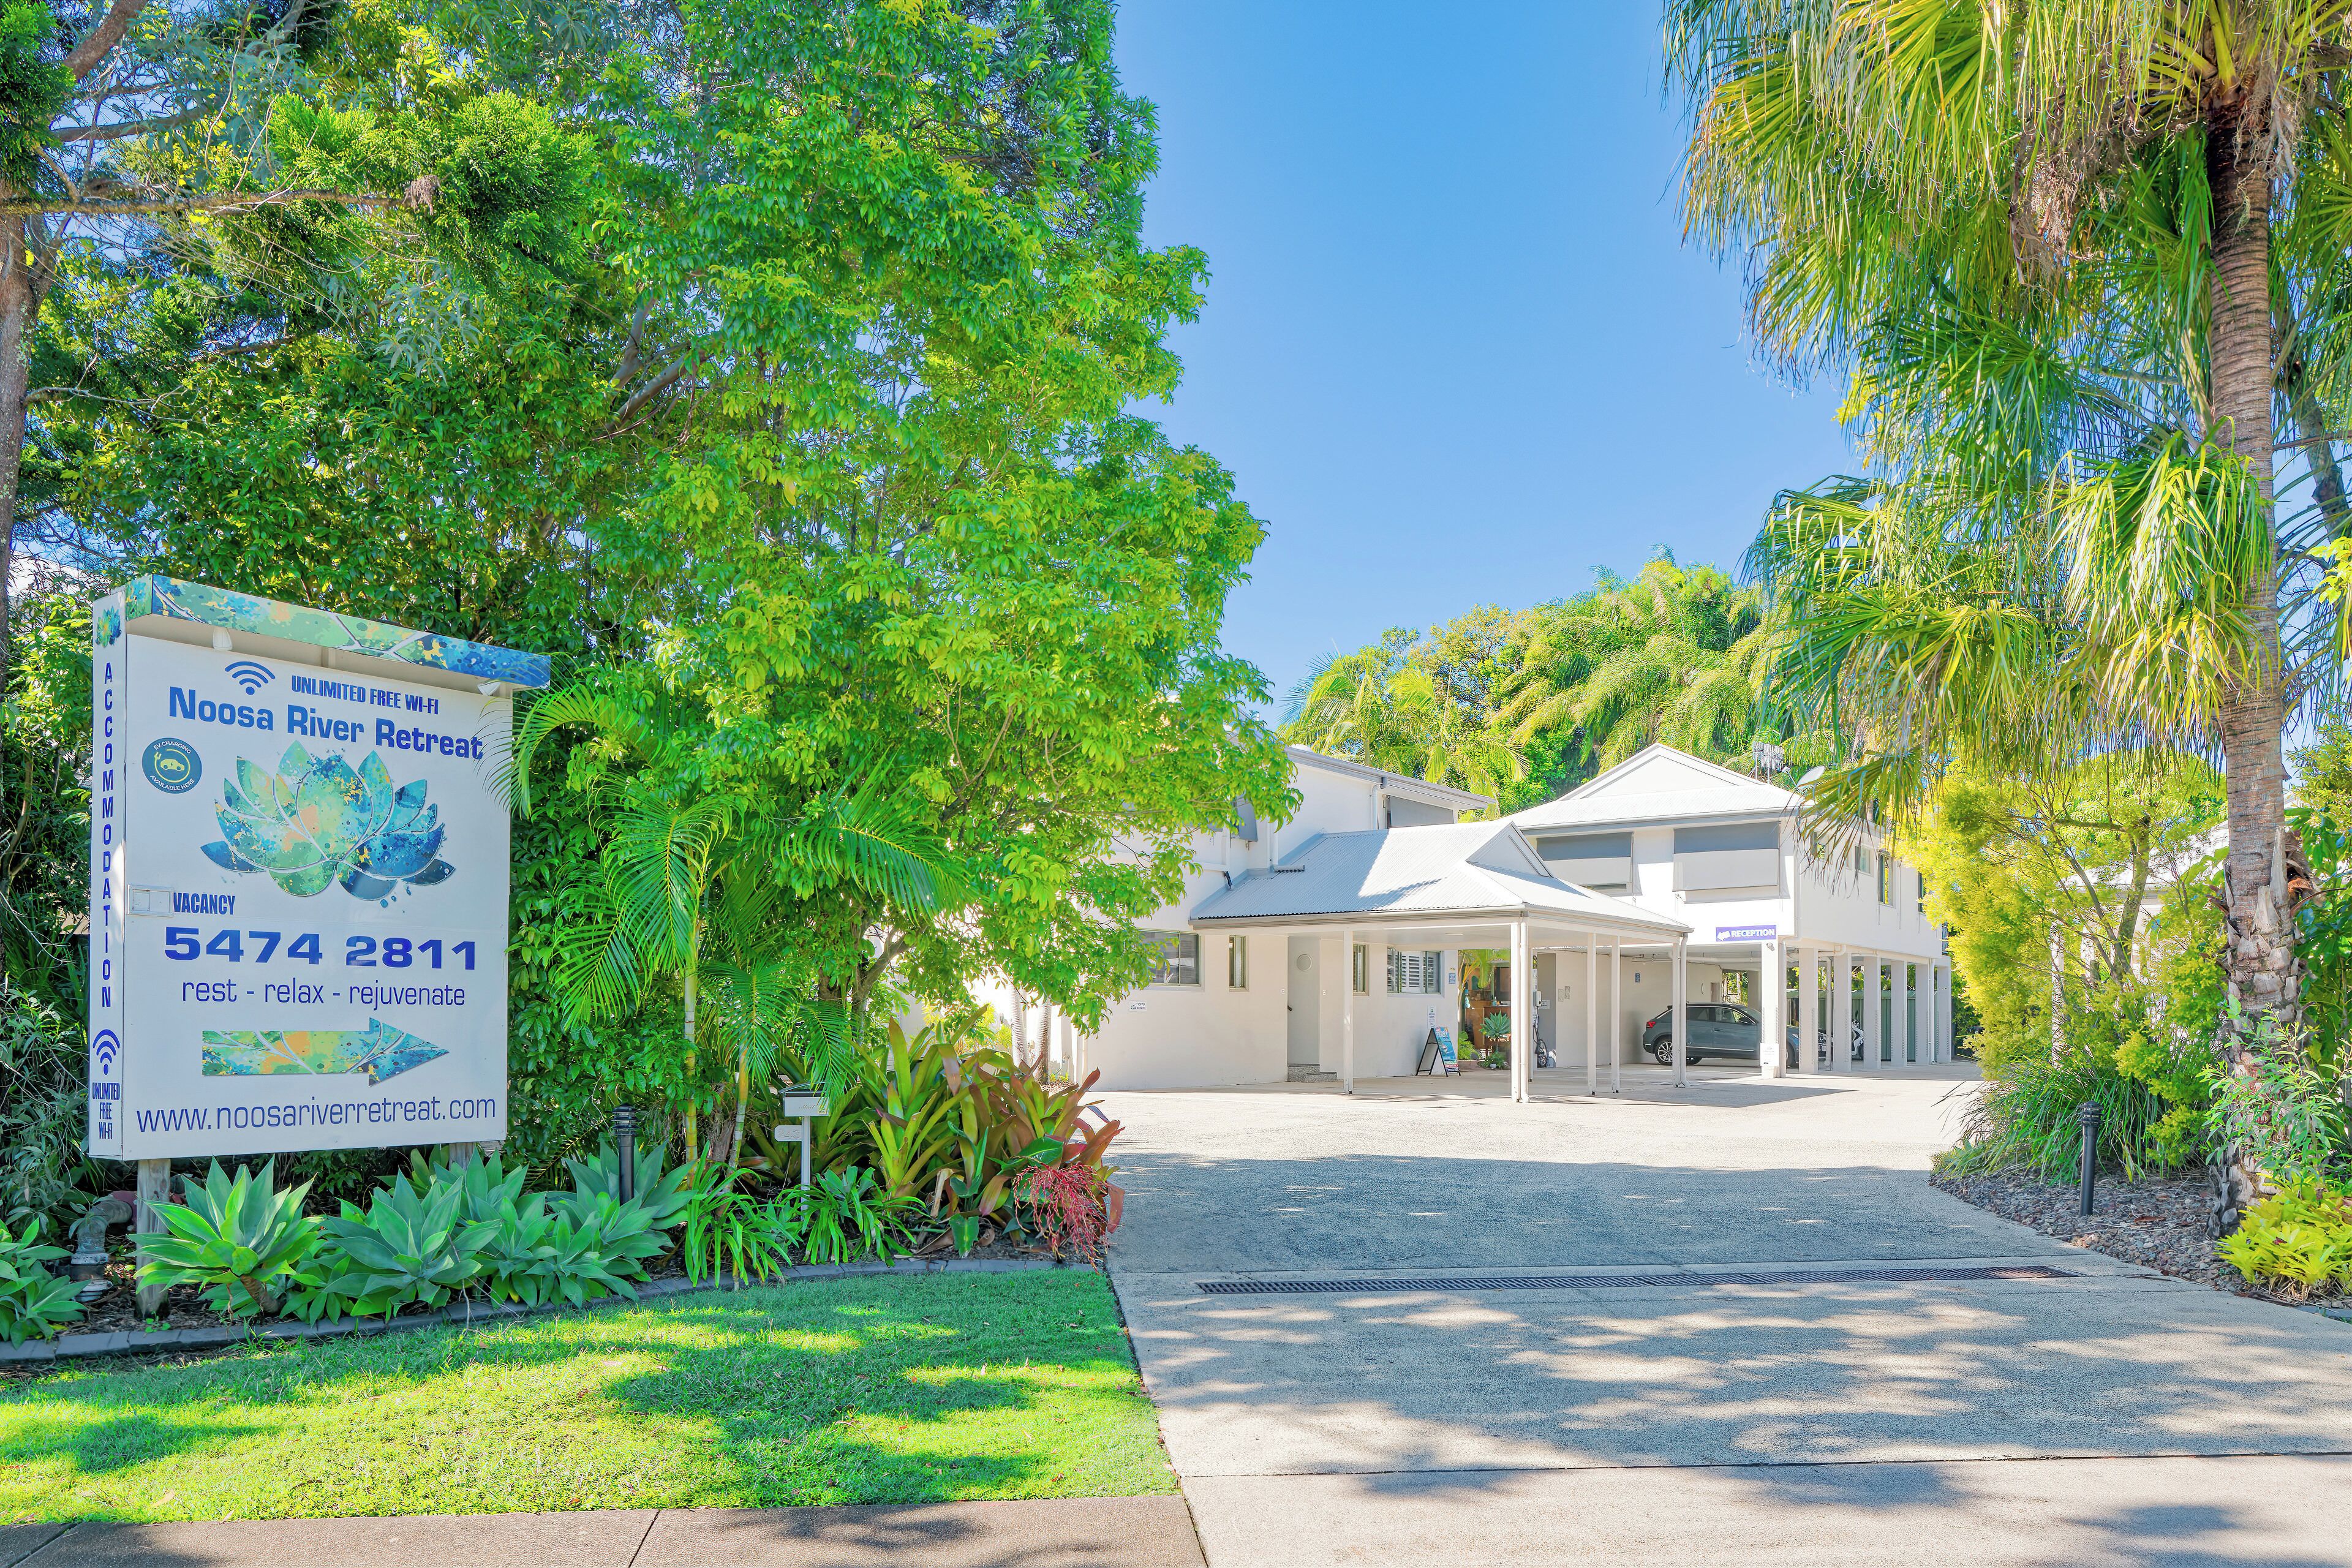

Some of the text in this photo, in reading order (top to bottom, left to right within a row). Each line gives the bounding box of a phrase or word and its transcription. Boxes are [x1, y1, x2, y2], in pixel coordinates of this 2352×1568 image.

[291, 675, 439, 715] UNLIMITED FREE WI-FI
[168, 685, 484, 760] Noosa River Retreat
[161, 740, 192, 754] CHARGING
[149, 774, 195, 791] AVAILABLE HERE
[102, 662, 114, 1008] ACCOMMODATION
[173, 892, 236, 915] VACANCY
[1730, 929, 1776, 938] RECEPTION
[164, 926, 475, 971] 5474 2811
[183, 979, 237, 1003] rest
[265, 977, 324, 1004] relax
[349, 979, 466, 1011] rejuvenate
[92, 1082, 121, 1101] UNLIMITED
[99, 1102, 112, 1120] FREE
[137, 1096, 496, 1133] www.noosariverretreat.com
[99, 1121, 113, 1140] WI-FI
